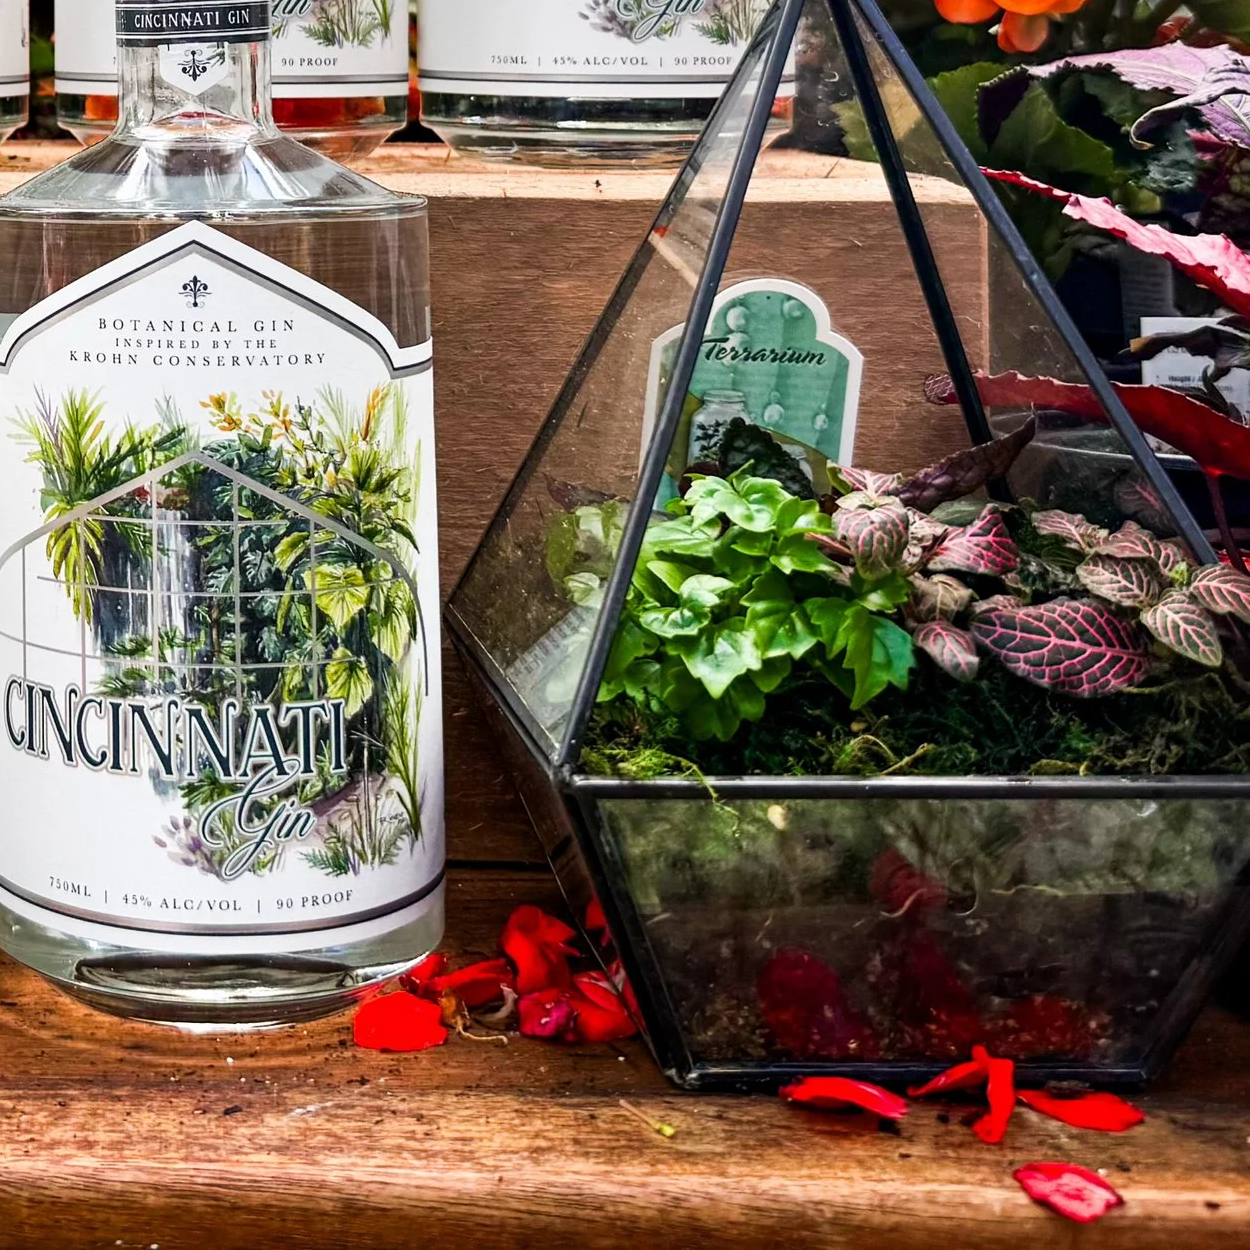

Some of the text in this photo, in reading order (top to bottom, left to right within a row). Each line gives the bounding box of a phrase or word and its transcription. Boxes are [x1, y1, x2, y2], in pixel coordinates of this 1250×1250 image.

[134, 8, 250, 29] CINCINNATI GIN
[281, 57, 338, 67] 90 PROOF
[552, 56, 577, 65] 45%
[582, 56, 648, 66] ALC/VOL
[674, 57, 688, 66] 90
[693, 56, 732, 66] PROOF
[98, 318, 295, 333] BOTANICAL GIN
[115, 338, 278, 349] INSPIRED BY THE
[701, 337, 826, 366] Terrarium
[69, 351, 326, 367] KROHN CONSERVATORY
[5, 678, 345, 778] CINCINNATI
[201, 758, 316, 878] Gin
[49, 876, 354, 911] 750ML 45% ALC/VOL 90 PROOF
